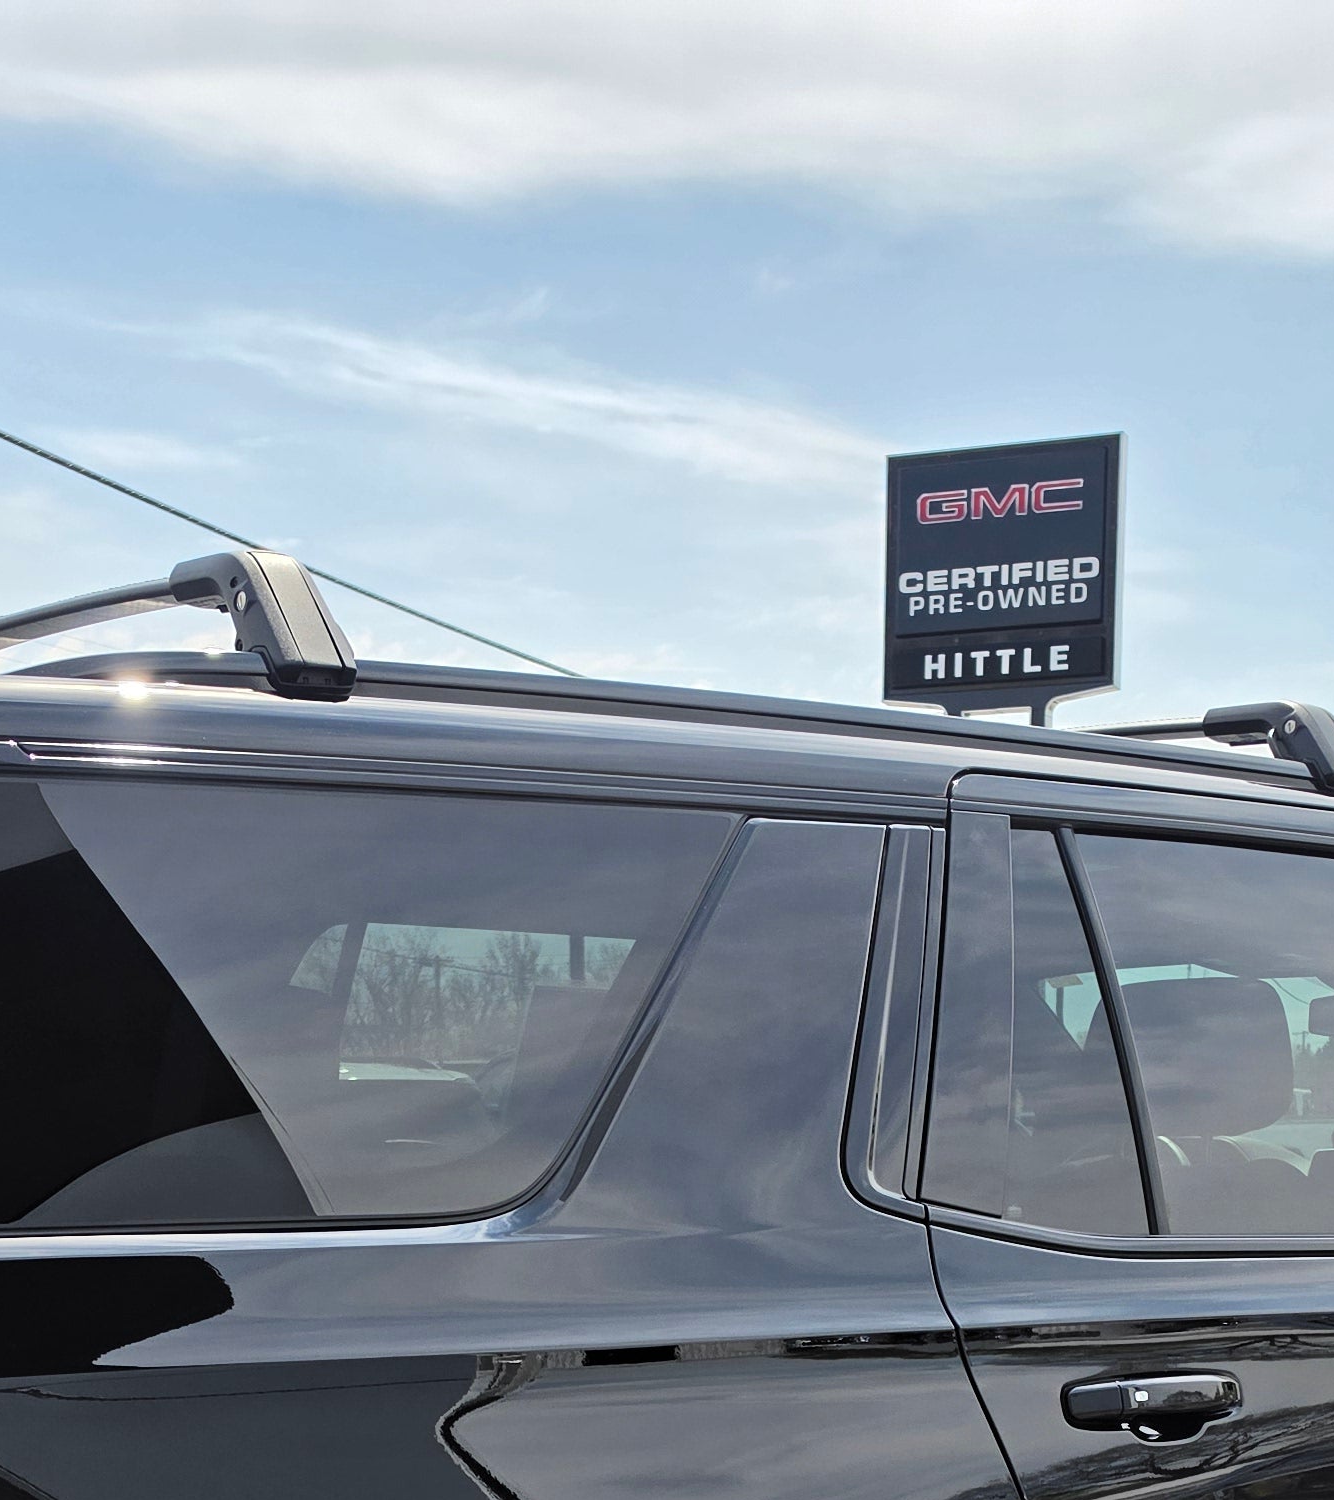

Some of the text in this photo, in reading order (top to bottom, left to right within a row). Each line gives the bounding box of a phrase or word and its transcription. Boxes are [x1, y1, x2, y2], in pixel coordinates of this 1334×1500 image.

[917, 478, 1084, 525] GMC
[898, 556, 1100, 594] CERTIFIED
[909, 582, 1088, 617] PRE-OWNED
[924, 645, 1070, 680] HITTLE
